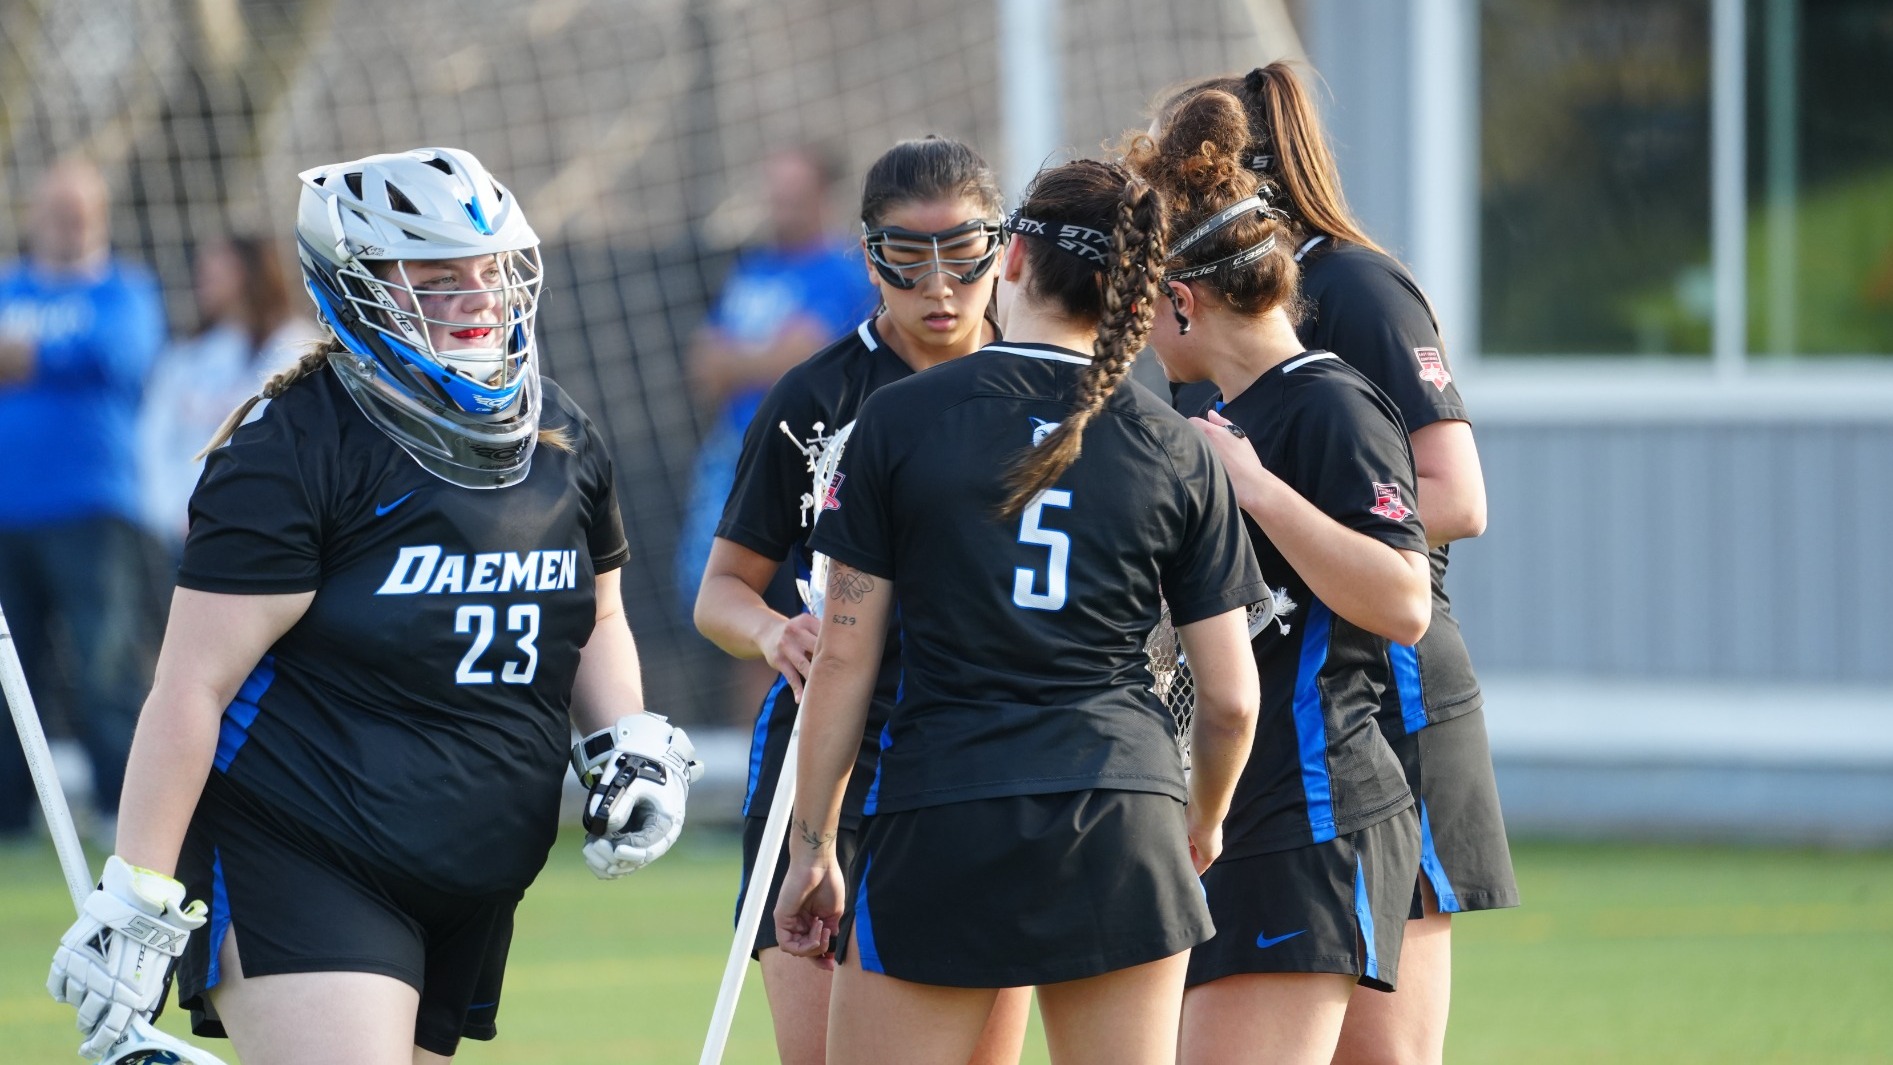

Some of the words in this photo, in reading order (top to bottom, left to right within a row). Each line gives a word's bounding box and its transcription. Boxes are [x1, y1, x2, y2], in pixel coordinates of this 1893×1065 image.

[1016, 218, 1047, 235] STX
[1058, 224, 1112, 246] STX
[1057, 239, 1108, 265] STX
[1012, 488, 1073, 613] 5
[374, 545, 577, 595] DAEMEN
[454, 603, 541, 685] 23
[121, 916, 186, 953] STX
